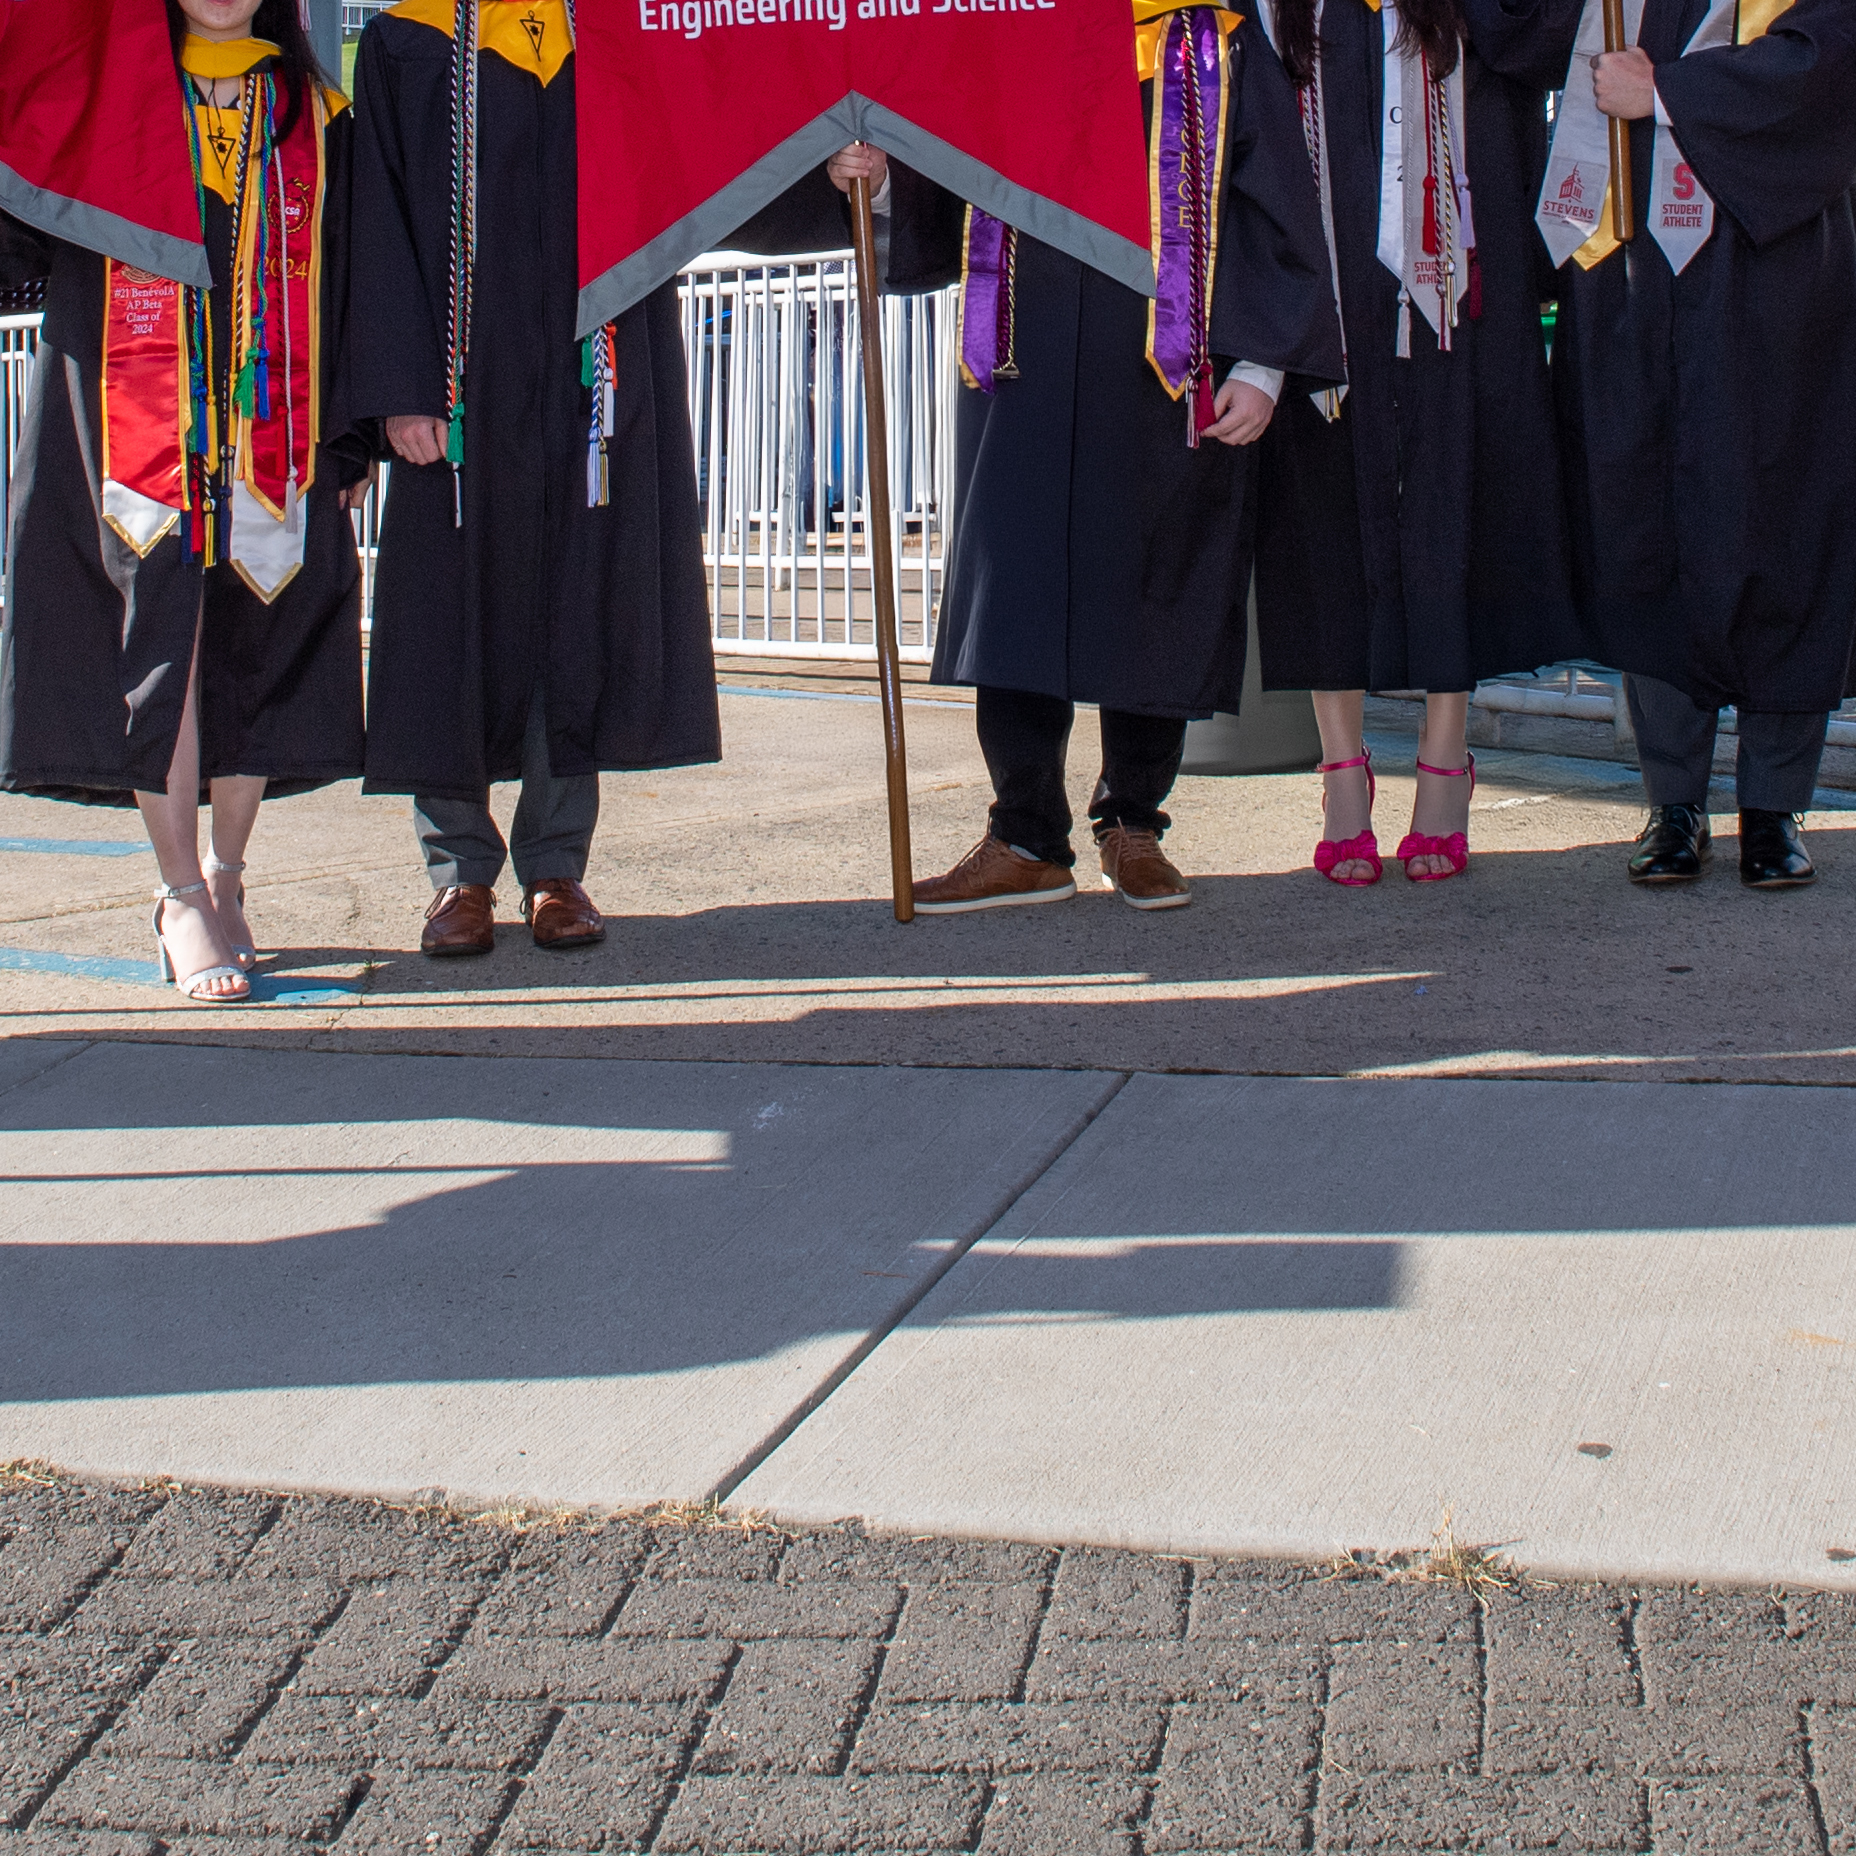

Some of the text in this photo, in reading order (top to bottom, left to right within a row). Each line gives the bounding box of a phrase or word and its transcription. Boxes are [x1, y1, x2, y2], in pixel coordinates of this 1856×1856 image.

[1673, 162, 1695, 200] S
[1543, 200, 1595, 220] STEVENS
[1662, 204, 1704, 215] STUDENT
[1662, 216, 1702, 227] ATHLETE
[142, 299, 162, 310] Beta
[126, 311, 161, 323] Class of
[131, 324, 154, 335] 2024
